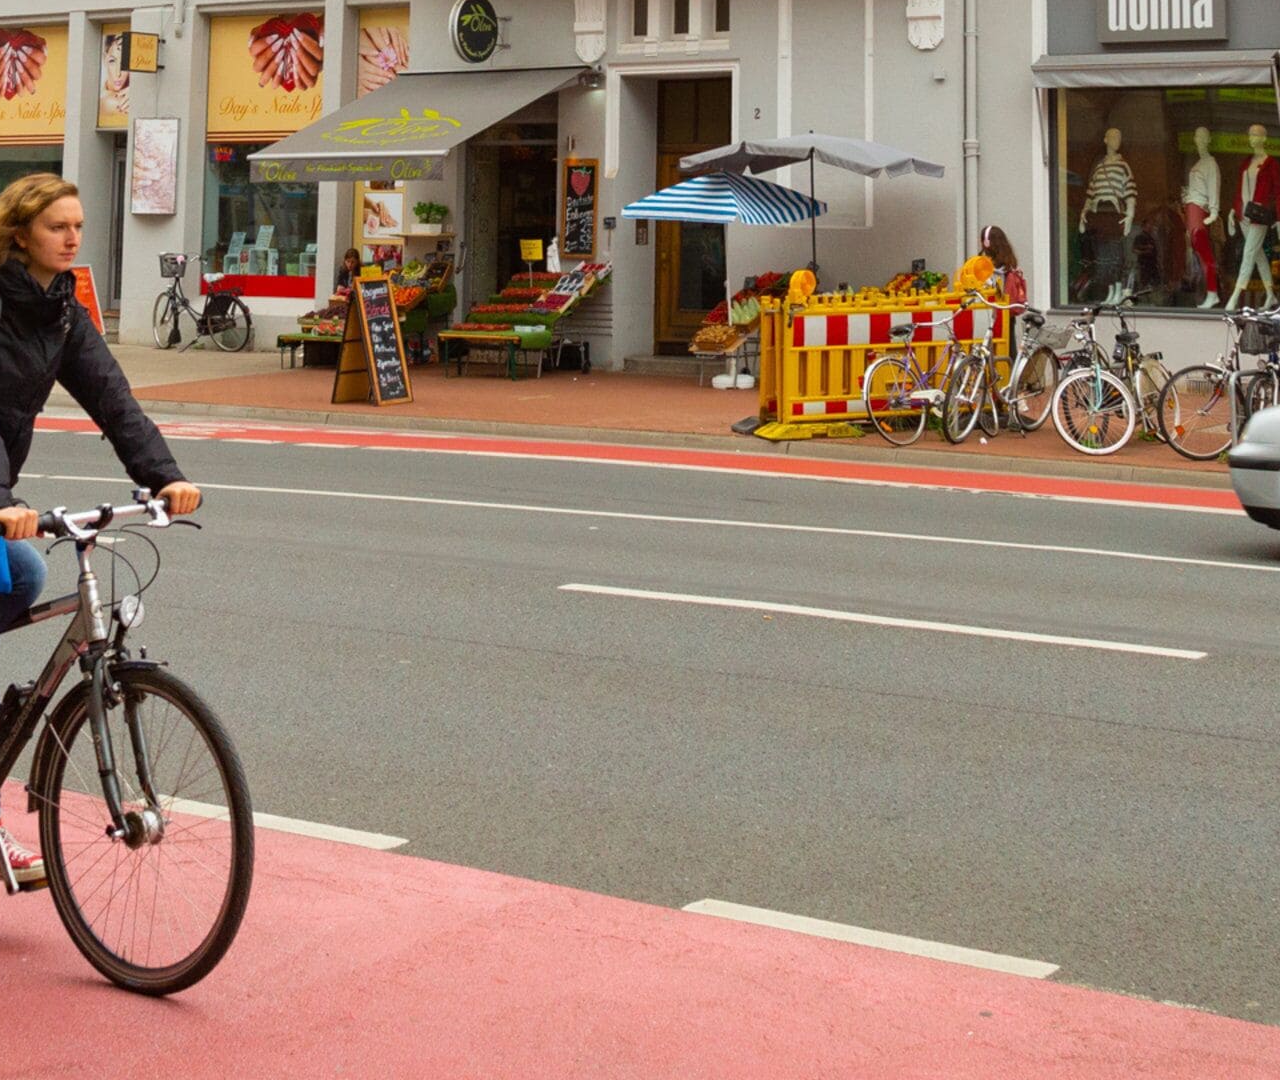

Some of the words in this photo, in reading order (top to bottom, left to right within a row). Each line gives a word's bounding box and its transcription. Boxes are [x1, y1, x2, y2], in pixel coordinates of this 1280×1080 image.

[11, 101, 42, 120] Nails
[218, 97, 258, 120] Day's
[265, 96, 301, 115] Nails
[305, 96, 322, 120] Sp
[754, 107, 761, 120] 2
[390, 159, 423, 179] Olive
